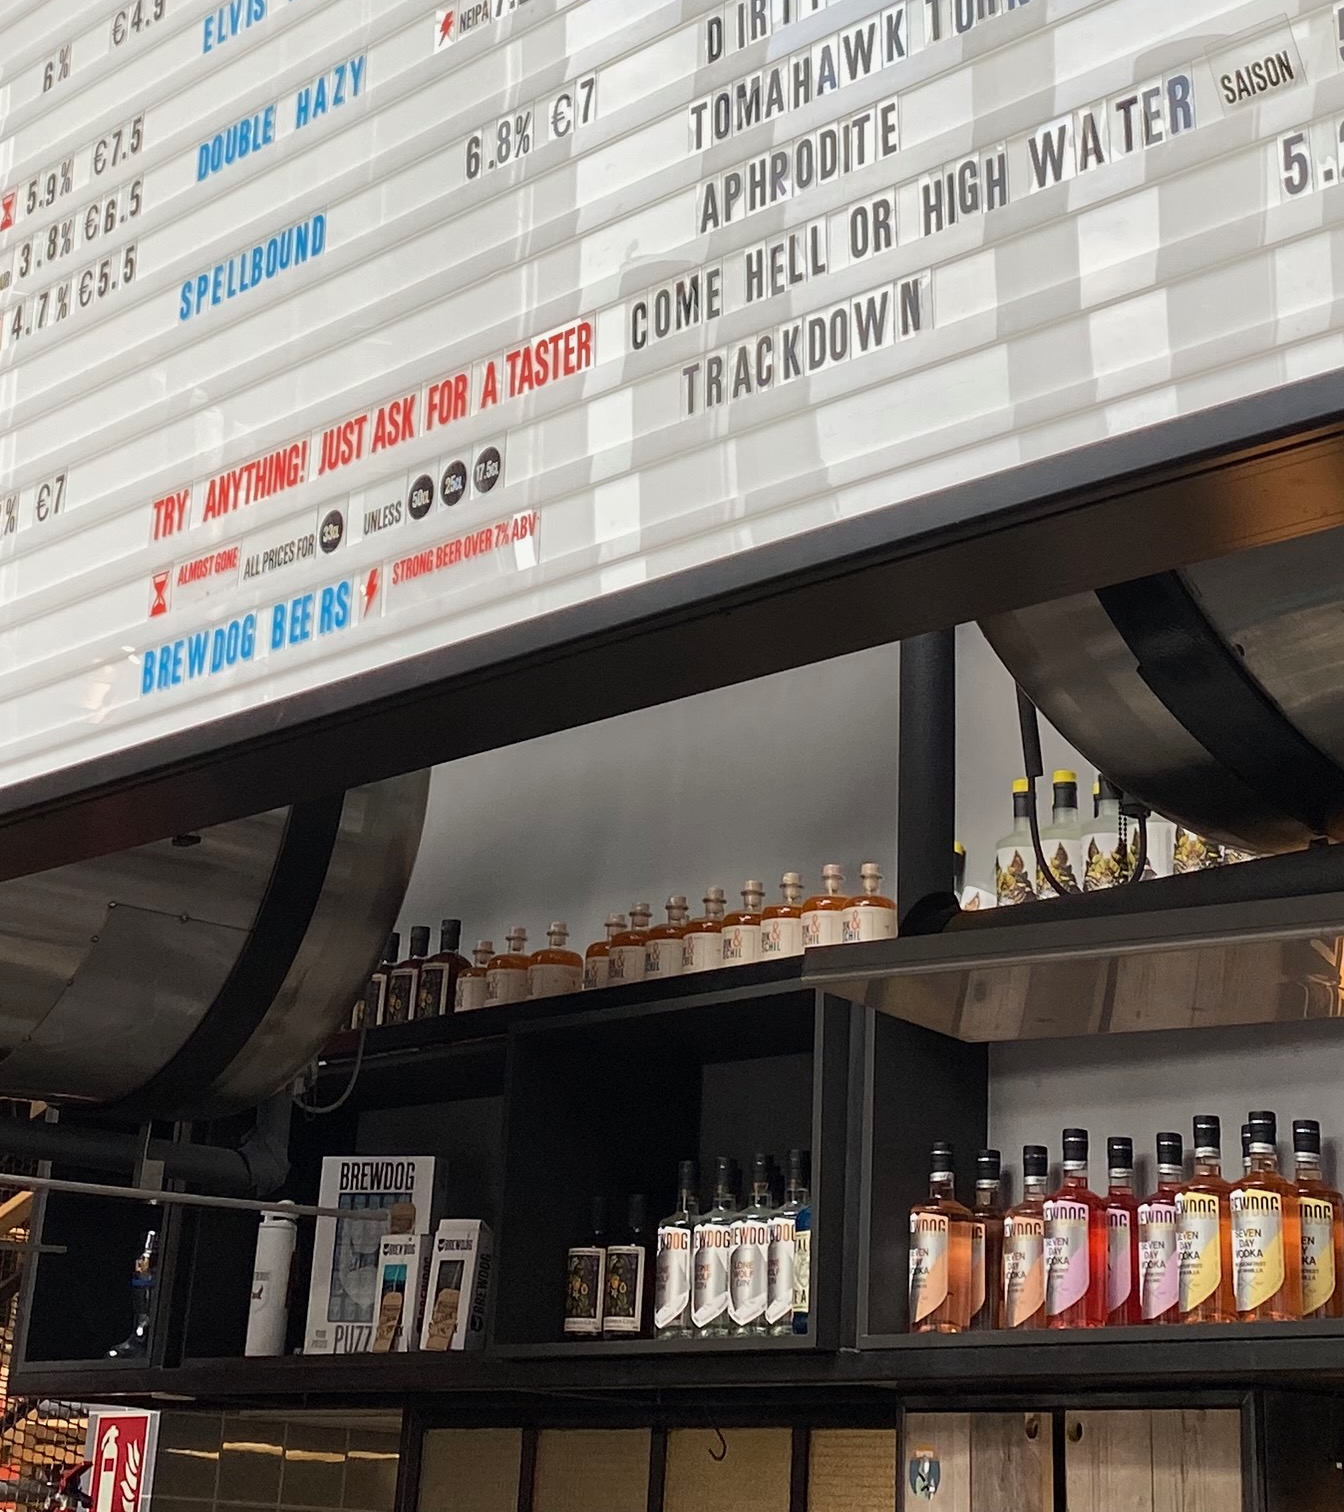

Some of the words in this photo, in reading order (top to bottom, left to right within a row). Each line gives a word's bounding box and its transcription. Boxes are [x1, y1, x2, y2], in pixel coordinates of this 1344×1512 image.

[196, 103, 275, 182] DOUBLE
[295, 55, 365, 130] HAZY
[459, 0, 490, 34] NEIPA
[691, 8, 905, 150] TOMAHAWK
[27, 158, 73, 215] 5.9%
[94, 116, 143, 175] €7.5
[179, 214, 325, 322] SPELLBOUND
[466, 111, 532, 180] 6.8%
[551, 76, 595, 138] €7
[632, 268, 720, 350] COME
[746, 225, 826, 303] HELL
[850, 198, 892, 259] OR
[923, 152, 1008, 236] HIGH
[1028, 74, 1192, 189] WATER
[1220, 50, 1295, 104] SAISON
[701, 102, 898, 234] APHRODITE
[20, 219, 73, 279] 3.8%
[84, 180, 142, 241] €6.5
[11, 283, 70, 341] 4.7%
[79, 245, 135, 308] €5.5
[682, 278, 921, 415] TRACKDOWN
[153, 489, 190, 541] TRY
[202, 440, 309, 522] ANYTHING!
[318, 414, 367, 475] JUST
[371, 393, 418, 453] ASK
[425, 373, 469, 431] FOR
[480, 361, 498, 409] A
[505, 321, 592, 398] TASTER
[35, 474, 66, 522] €7
[243, 557, 260, 581] ALL
[262, 542, 295, 573] PRICES
[297, 534, 315, 558] FOR
[364, 500, 403, 536] UNLESS
[177, 555, 215, 587] ALMOST
[215, 546, 239, 572] GONE
[392, 549, 434, 585] STRONG
[435, 538, 461, 568] BEER
[463, 528, 493, 558] OVER
[494, 521, 509, 549] 7%
[510, 511, 538, 543] ABV
[142, 613, 255, 695] BREWDOG
[271, 580, 350, 651] BEERS
[339, 1162, 416, 1191] BREWDOG
[1235, 1228, 1262, 1239] SEVEN
[1239, 1239, 1255, 1248] DAY
